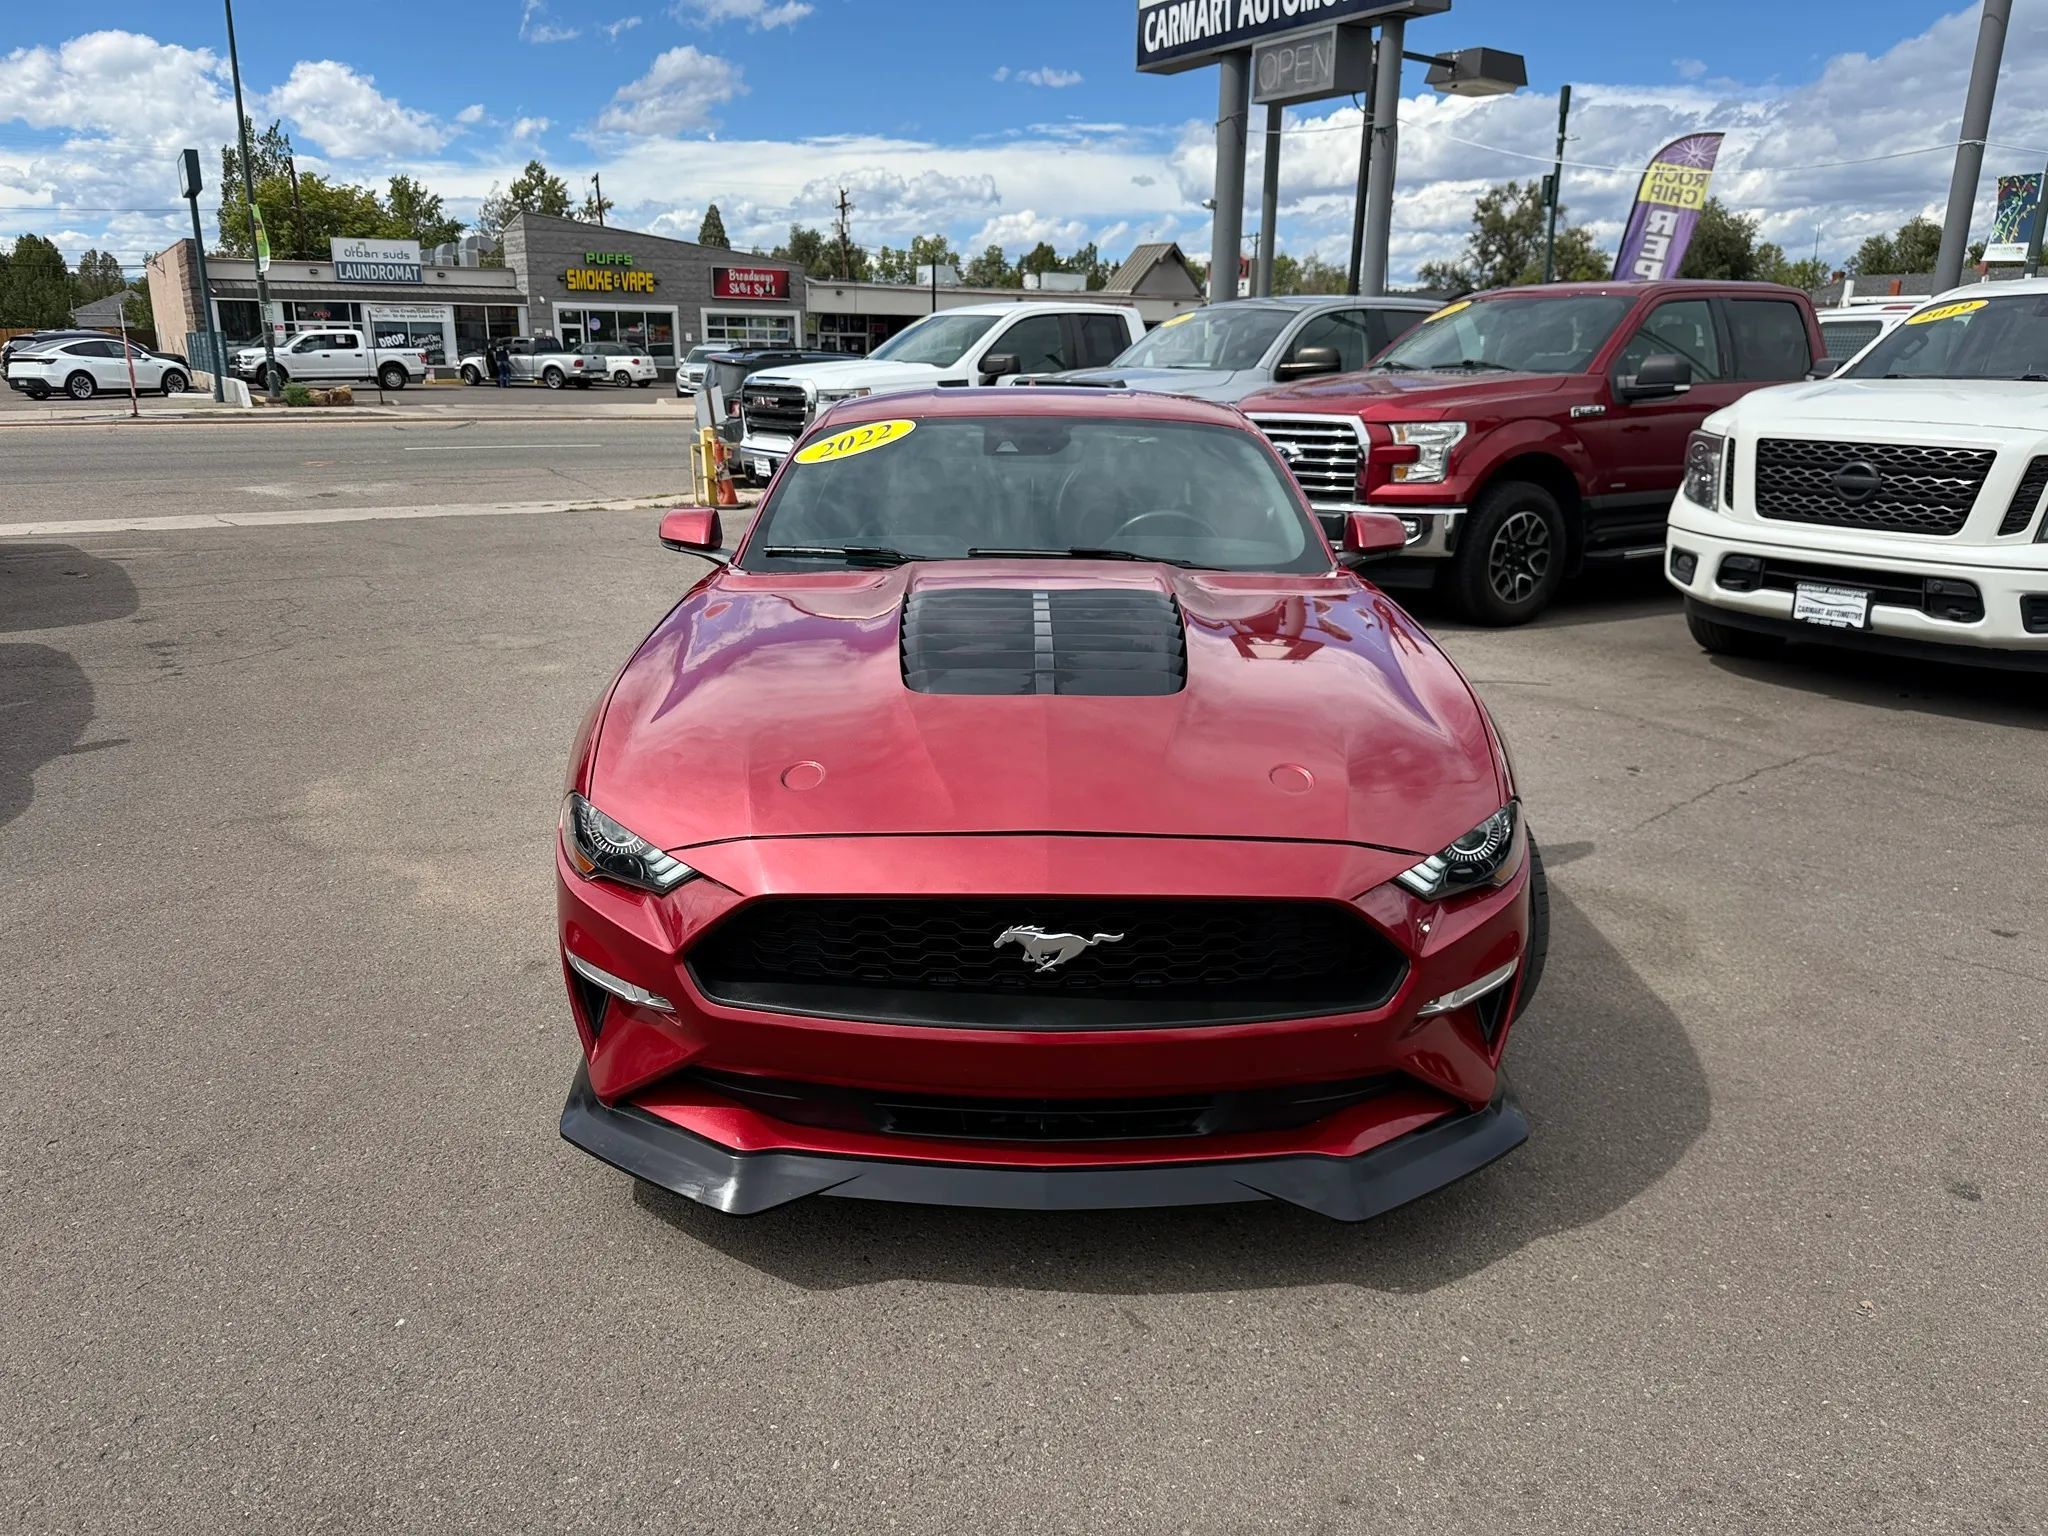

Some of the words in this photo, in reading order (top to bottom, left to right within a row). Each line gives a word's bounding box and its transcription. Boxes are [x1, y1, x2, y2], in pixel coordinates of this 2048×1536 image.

[1144, 0, 1231, 53] CARMART
[1258, 42, 1331, 92] OPEN
[382, 251, 410, 260] suds
[585, 252, 633, 265] PUFFS
[338, 263, 419, 281] LAUNDROMAT
[566, 269, 613, 291] SMOKE
[620, 271, 654, 293] VAPE
[378, 334, 406, 348] DROP
[818, 424, 892, 459] 2022
